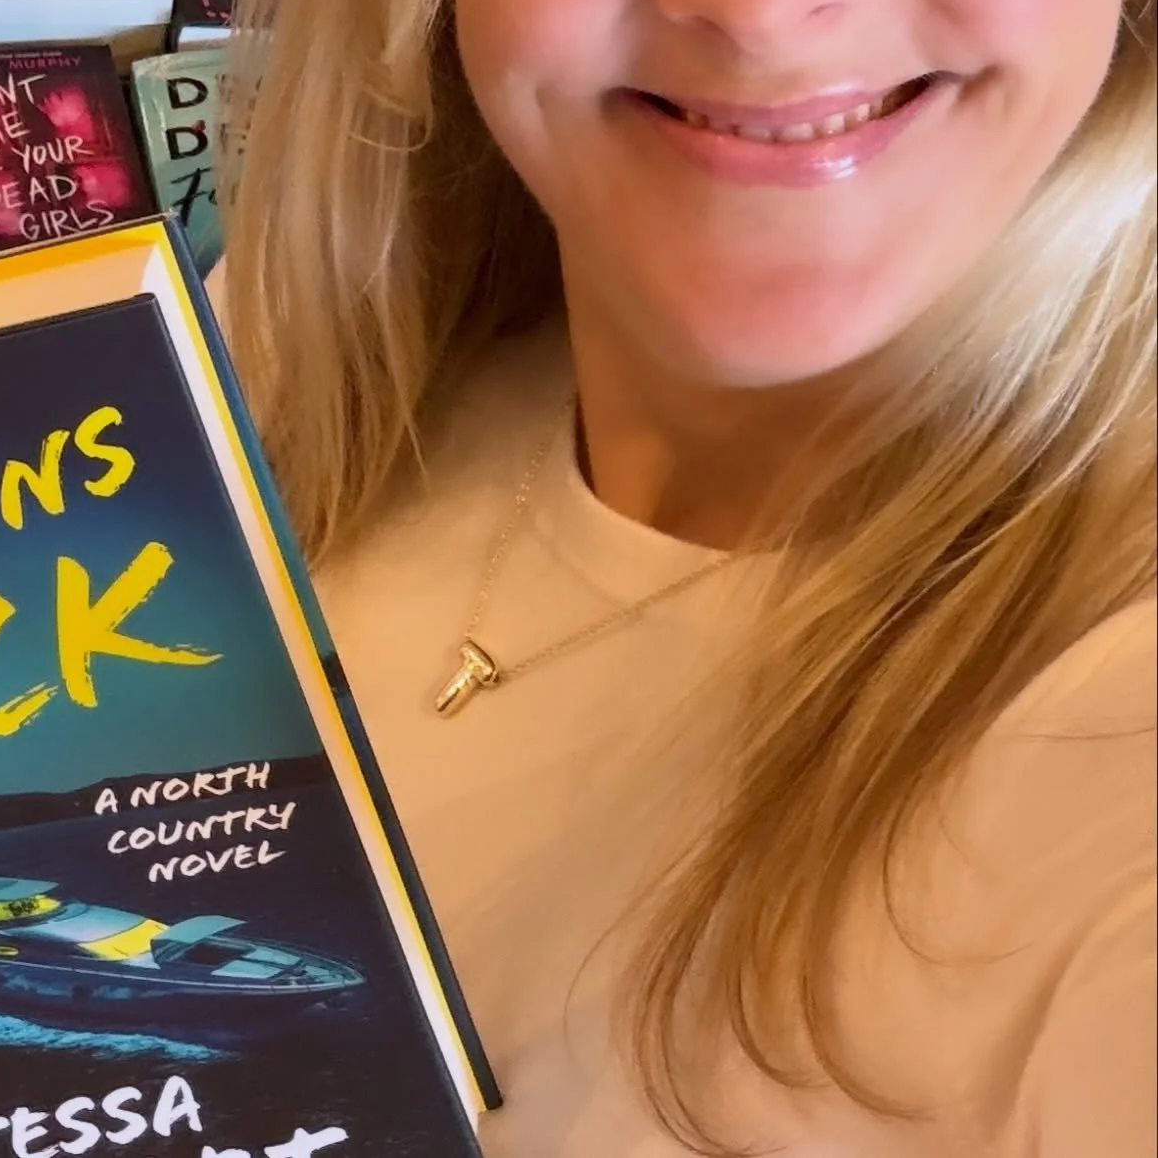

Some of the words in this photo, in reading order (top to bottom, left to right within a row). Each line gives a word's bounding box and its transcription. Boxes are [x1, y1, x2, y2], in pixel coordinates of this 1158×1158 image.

[9, 56, 81, 70] MURPHY
[11, 135, 95, 173] YOUR
[19, 201, 115, 240] GIRLS
[95, 787, 119, 815] A
[130, 761, 271, 808] NORTH
[107, 802, 297, 854] COUNTRY
[148, 840, 287, 883] NOVEL
